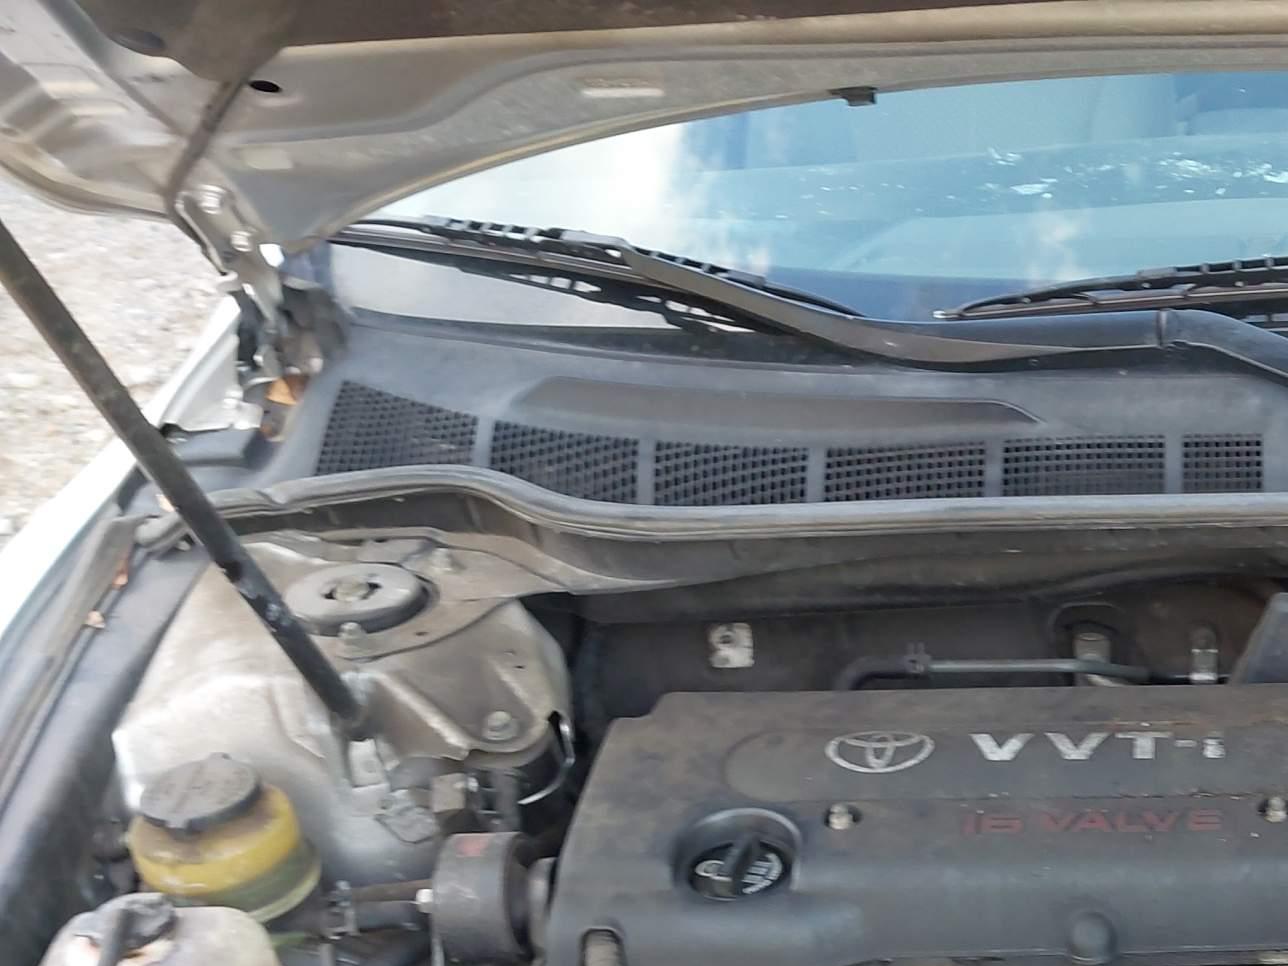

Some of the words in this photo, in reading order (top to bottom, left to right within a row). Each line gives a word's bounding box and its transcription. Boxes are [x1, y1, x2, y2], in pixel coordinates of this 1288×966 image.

[968, 731, 1226, 761] VVT-i
[963, 813, 1026, 836] 16
[1041, 809, 1224, 833] VALVE
